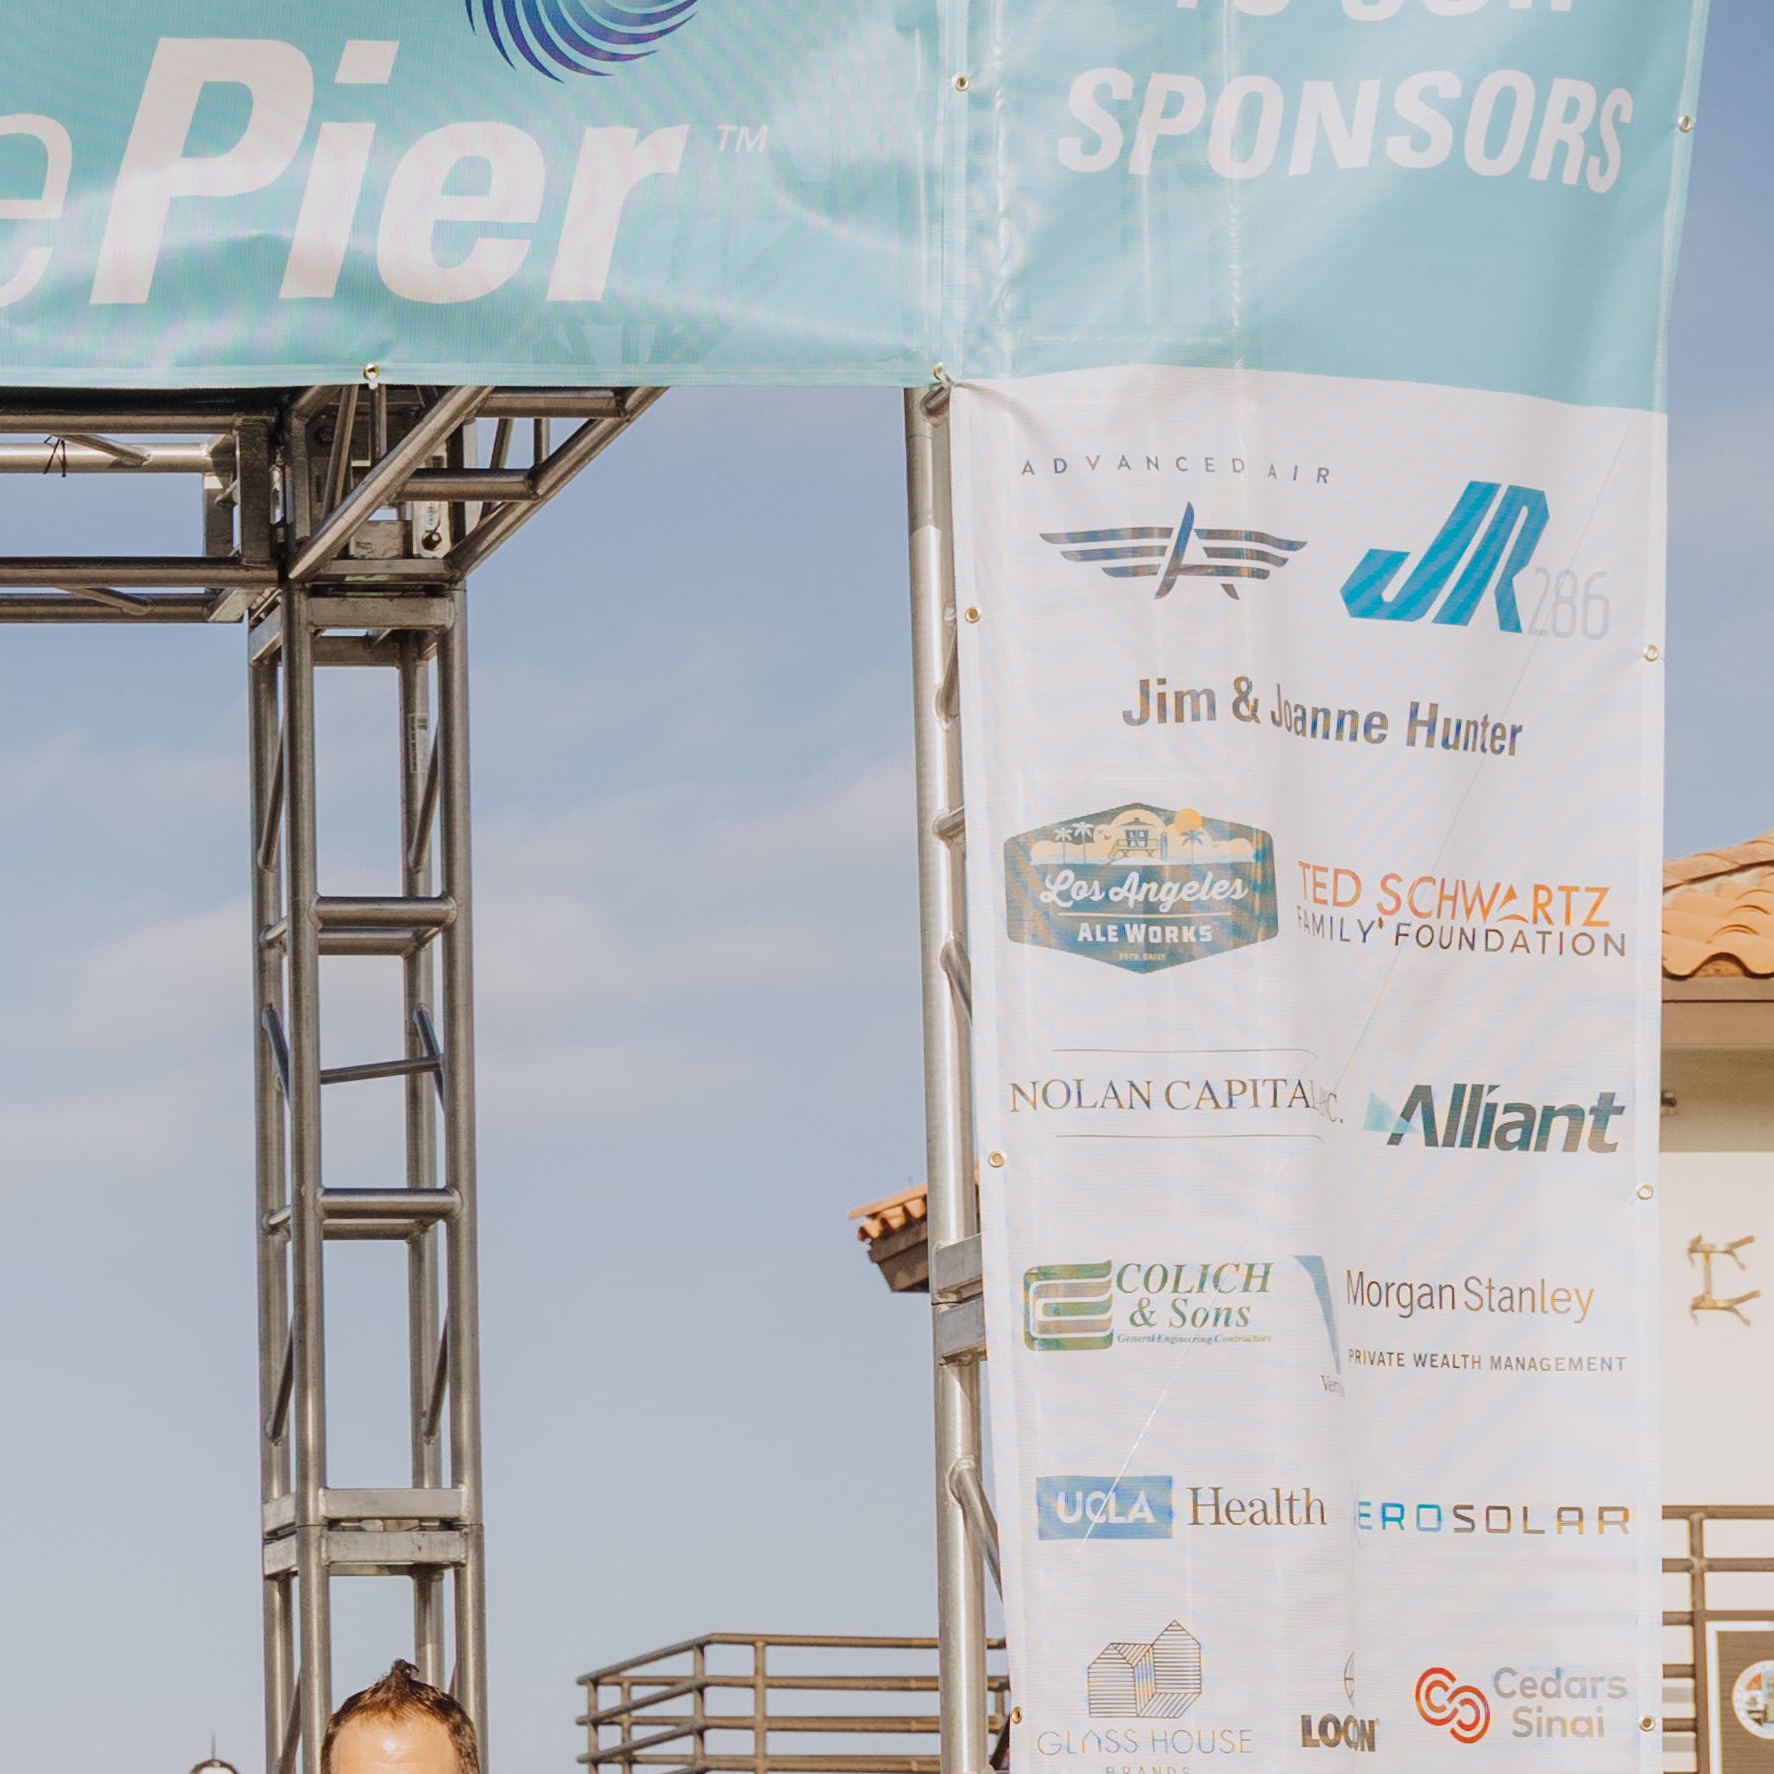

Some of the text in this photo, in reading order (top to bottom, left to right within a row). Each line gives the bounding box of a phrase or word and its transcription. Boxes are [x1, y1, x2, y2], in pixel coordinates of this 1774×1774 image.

[1058, 67, 1632, 194] SPONSORS
[1021, 455, 1330, 484] ADVANCED AIR
[1122, 676, 1523, 757] Jim & Joanne Hunter
[1040, 869, 1248, 912] Los Angeles
[1298, 860, 1362, 908] TED
[1395, 923, 1625, 956] FOUNDATION
[1011, 1079, 1151, 1112] NOLAN
[1386, 1083, 1626, 1153] Alliant
[1116, 1262, 1275, 1294] COLICH
[1129, 1297, 1251, 1328] & Sons
[1346, 1270, 1595, 1323] Morgan Stanley
[1117, 1333, 1155, 1344] General
[1157, 1334, 1212, 1345] Engineering
[1349, 1348, 1627, 1372] PRIVATE WEALTH MANAGEMENT
[1057, 1486, 1328, 1527] UCLA Health
[1357, 1501, 1631, 1534] EROSOLAR
[1493, 1666, 1628, 1700] Cedars
[1512, 1704, 1604, 1739] Sinai
[1151, 1728, 1253, 1755] HOUSE
